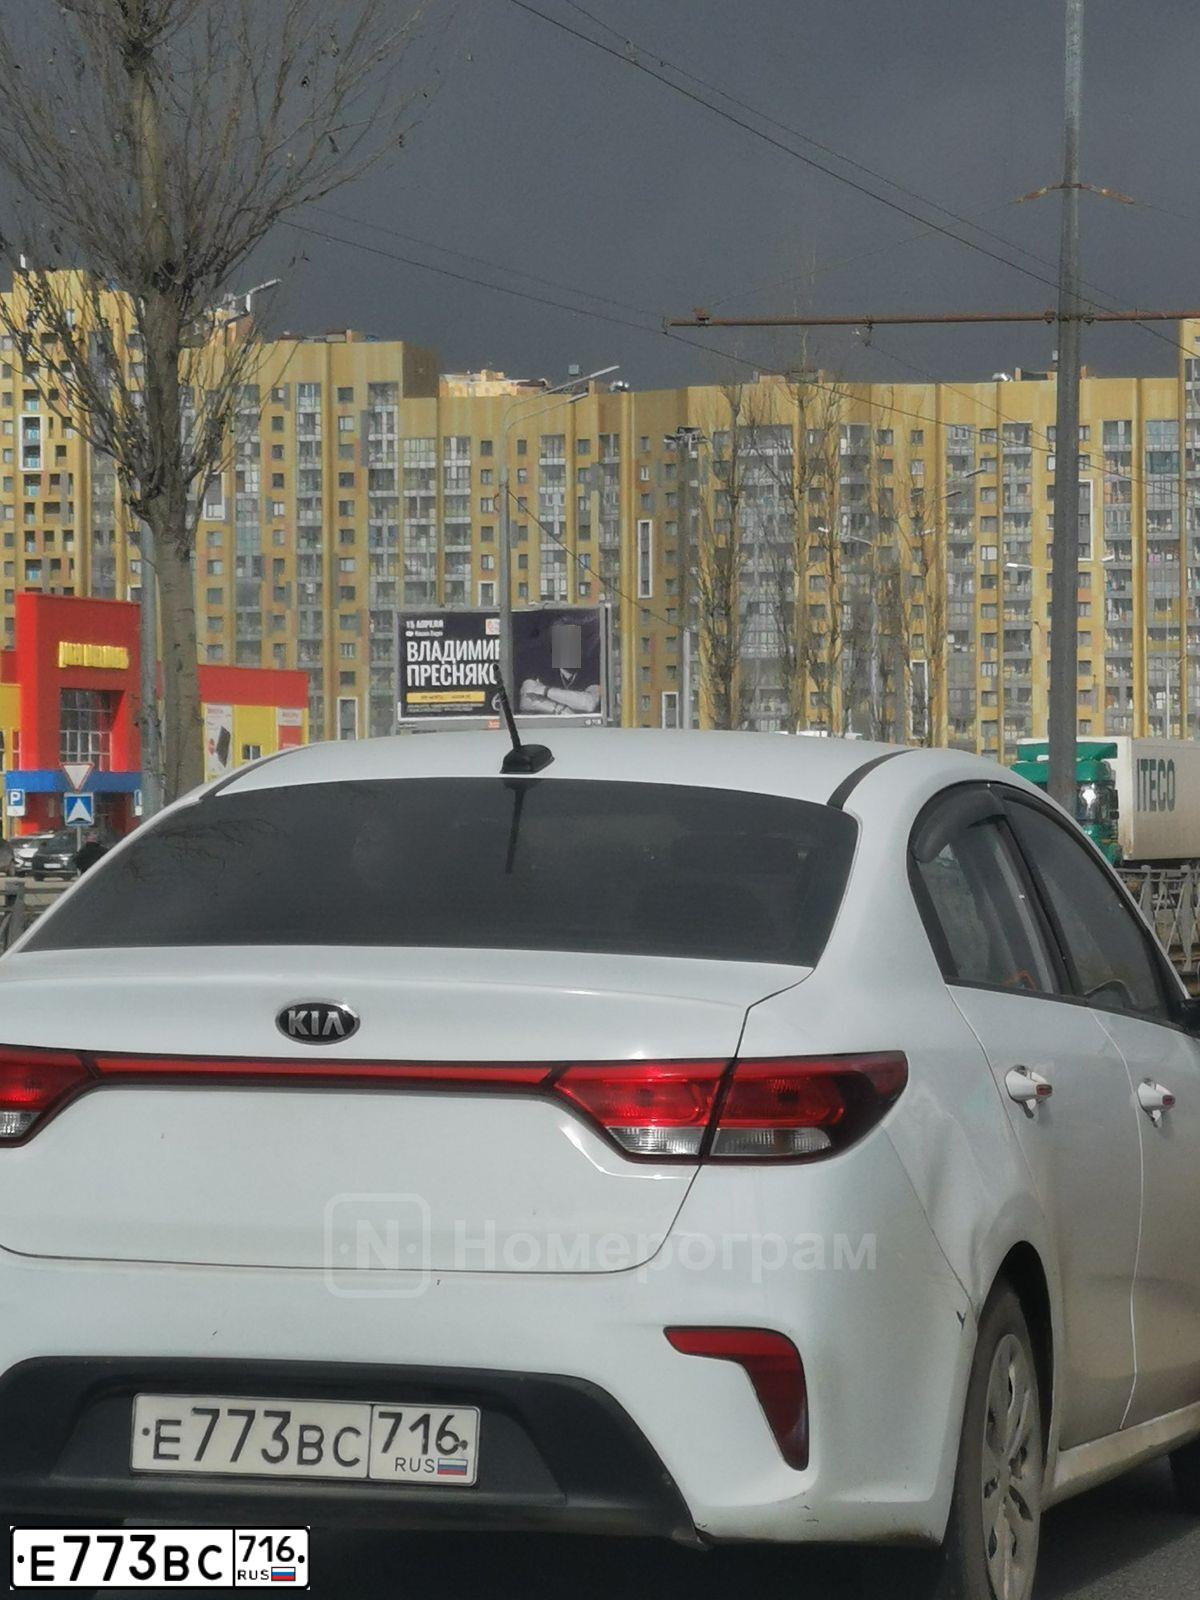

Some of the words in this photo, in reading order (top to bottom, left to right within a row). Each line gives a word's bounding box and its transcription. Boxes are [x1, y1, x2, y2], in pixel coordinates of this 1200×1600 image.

[1136, 758, 1176, 812] ITECO
[288, 1010, 346, 1036] KIA
[152, 1406, 362, 1468] Е773ВС
[377, 1411, 460, 1456] 716
[394, 1456, 436, 1473] RUS
